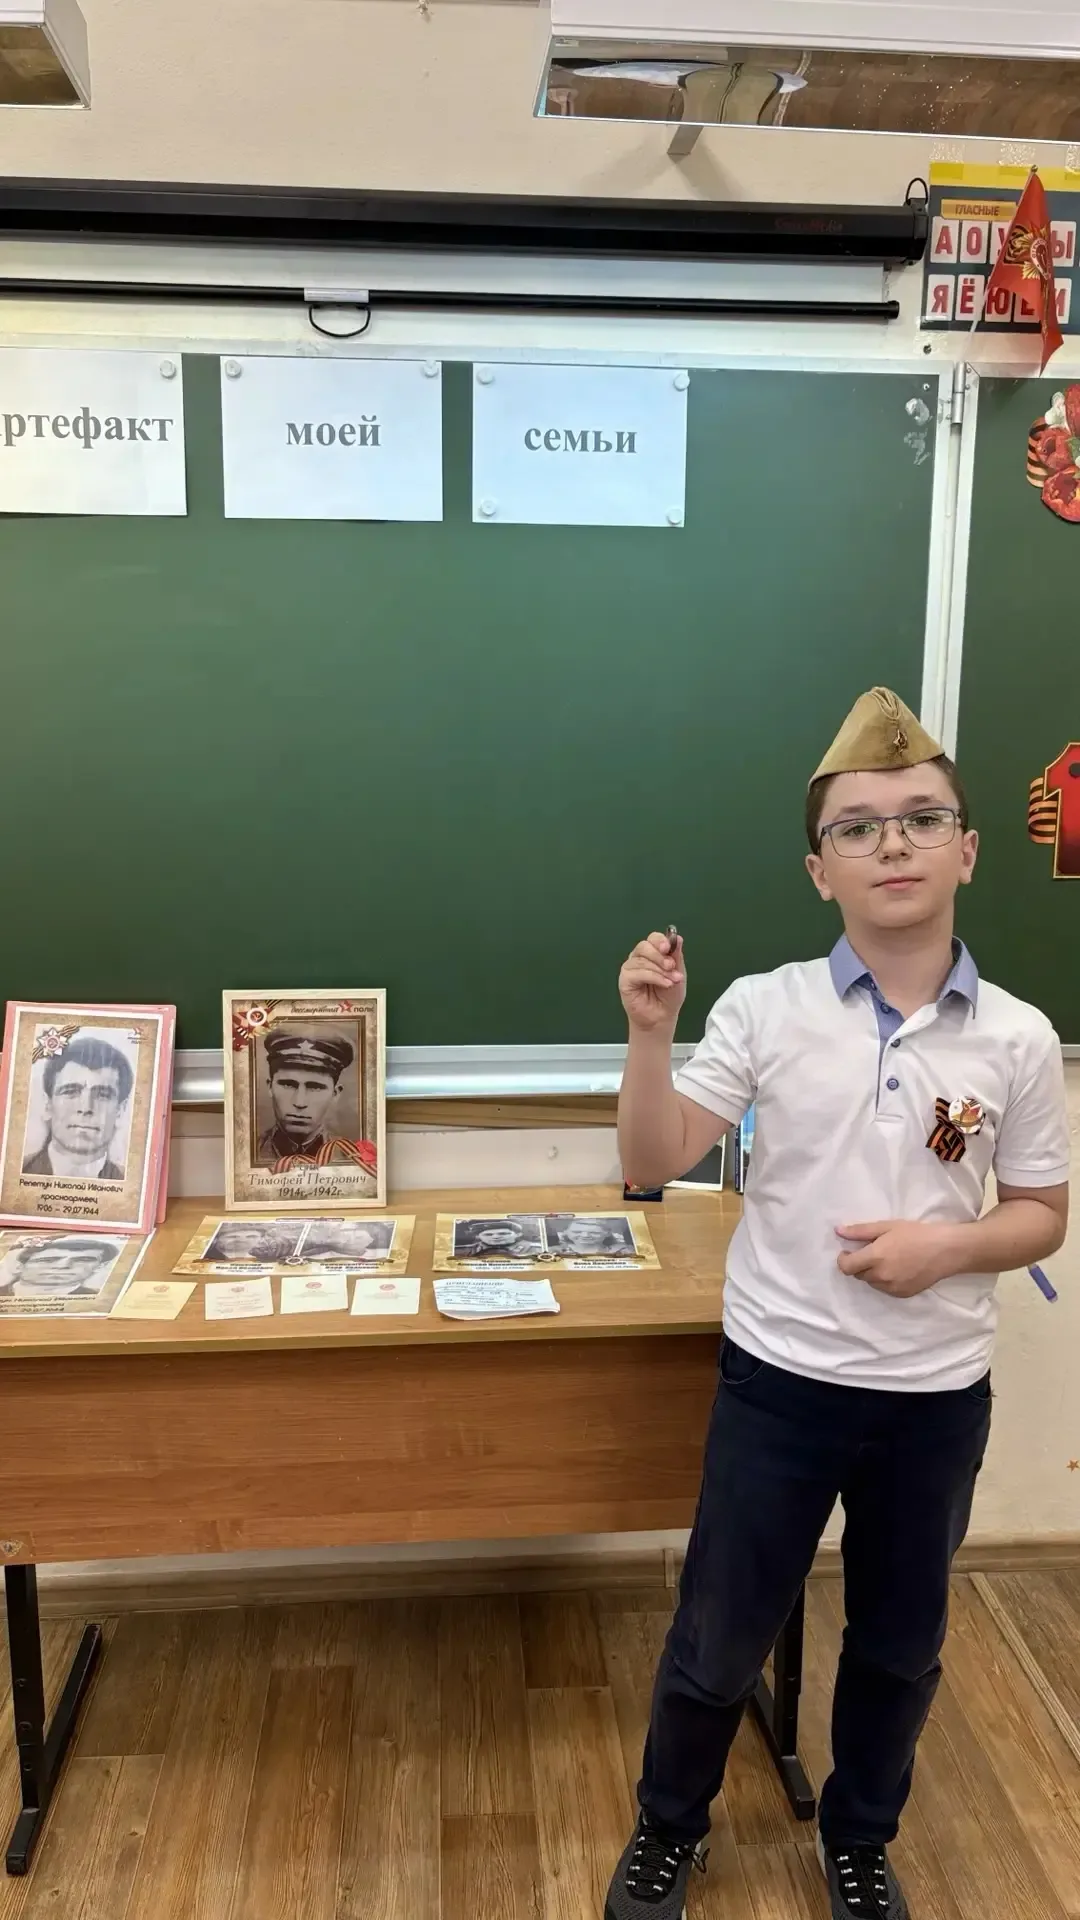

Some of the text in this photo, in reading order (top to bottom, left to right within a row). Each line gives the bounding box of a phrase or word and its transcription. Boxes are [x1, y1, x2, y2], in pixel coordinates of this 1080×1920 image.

[955, 204, 1000, 217] ГЛАСНЫЕ
[935, 226, 953, 255] А
[966, 227, 983, 256] О
[931, 285, 949, 313] Я
[960, 278, 976, 314] Ё
[0, 406, 638, 454] ртефакт моей семьи
[54, 1180, 86, 1191] Николай
[87, 1183, 123, 1193] Иванович
[248, 1173, 367, 1187] Тимофей Петрович
[40, 1193, 98, 1204] красноармеец
[36, 1203, 53, 1212] 1906
